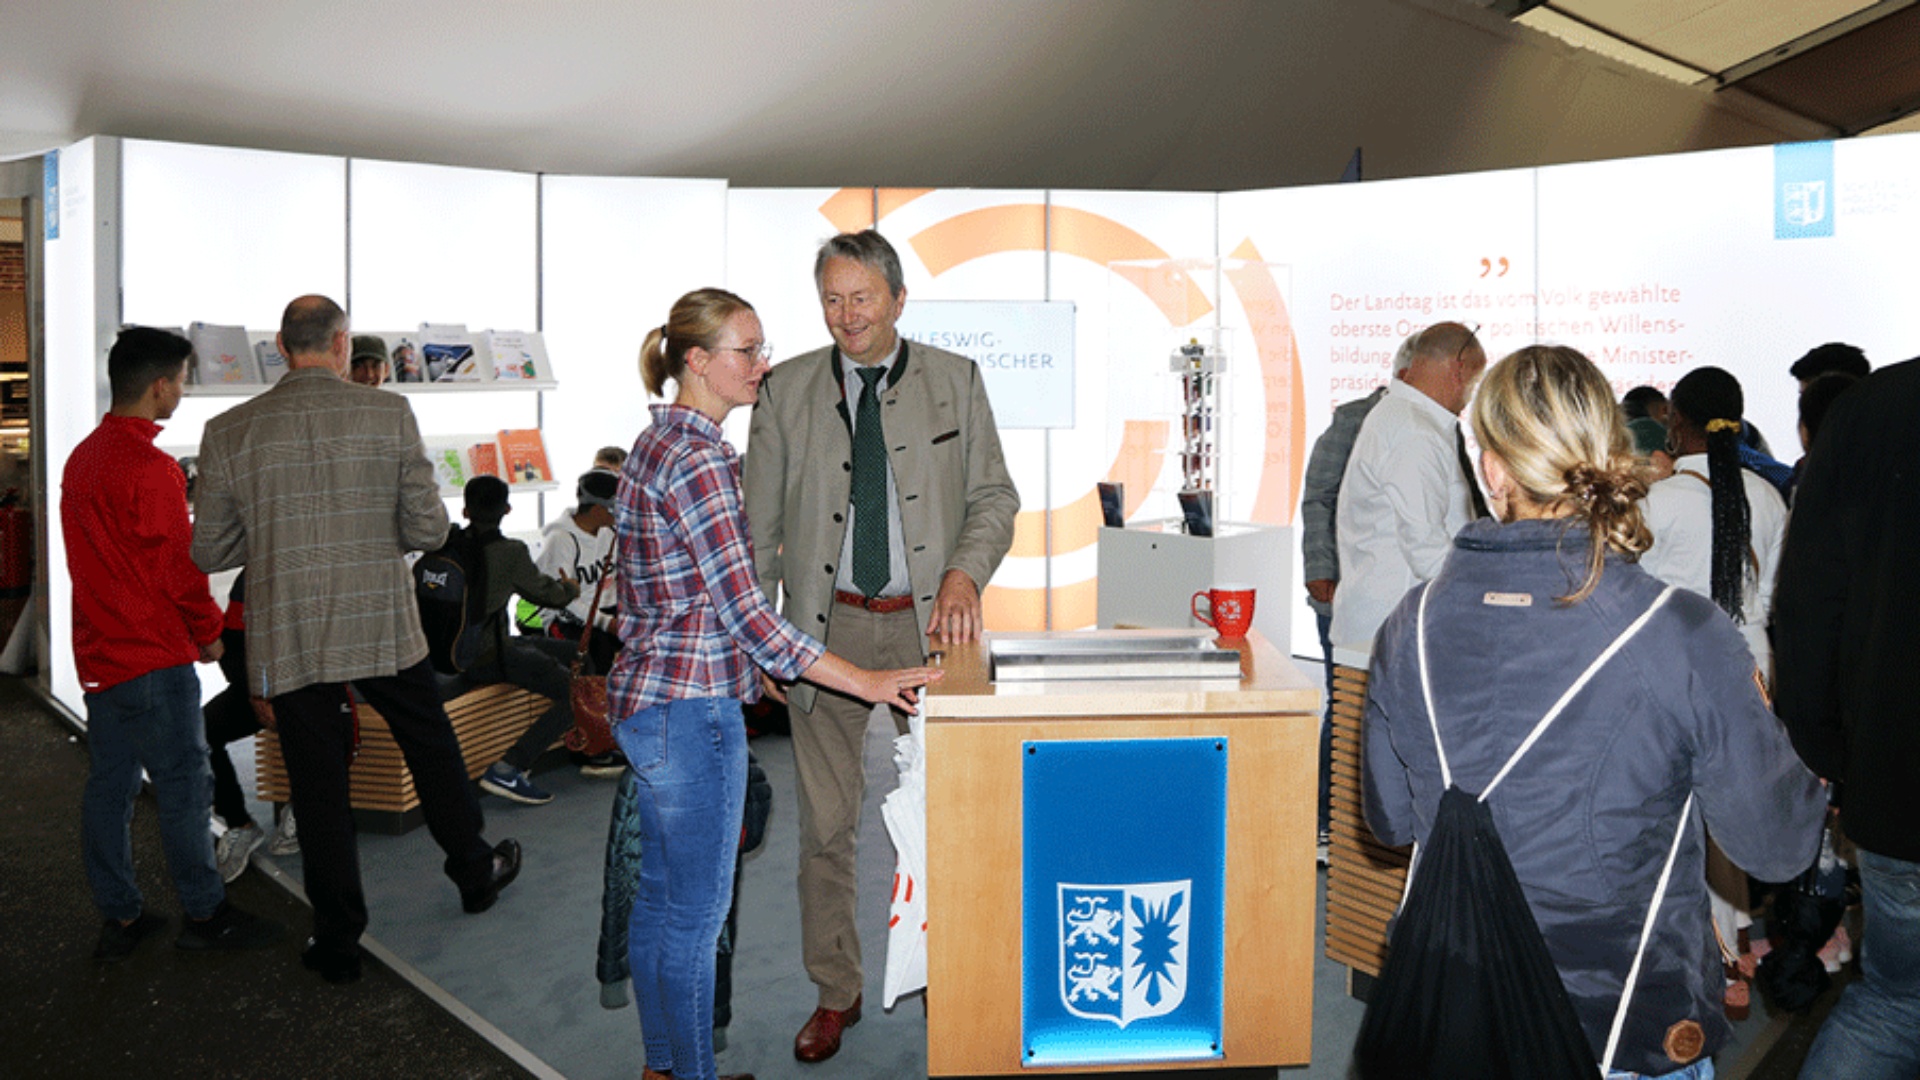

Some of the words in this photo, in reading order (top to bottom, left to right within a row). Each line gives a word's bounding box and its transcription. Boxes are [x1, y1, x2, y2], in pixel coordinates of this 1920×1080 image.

[1330, 293, 1360, 311] Der
[1365, 292, 1433, 315] Landtag
[1437, 292, 1457, 309] ist
[1461, 290, 1491, 309] das
[1540, 286, 1582, 305] Volk
[1330, 319, 1392, 338] oberste
[1490, 314, 1593, 339] politischen
[1600, 314, 1685, 334] Willens-
[1602, 345, 1693, 365] Minister-
